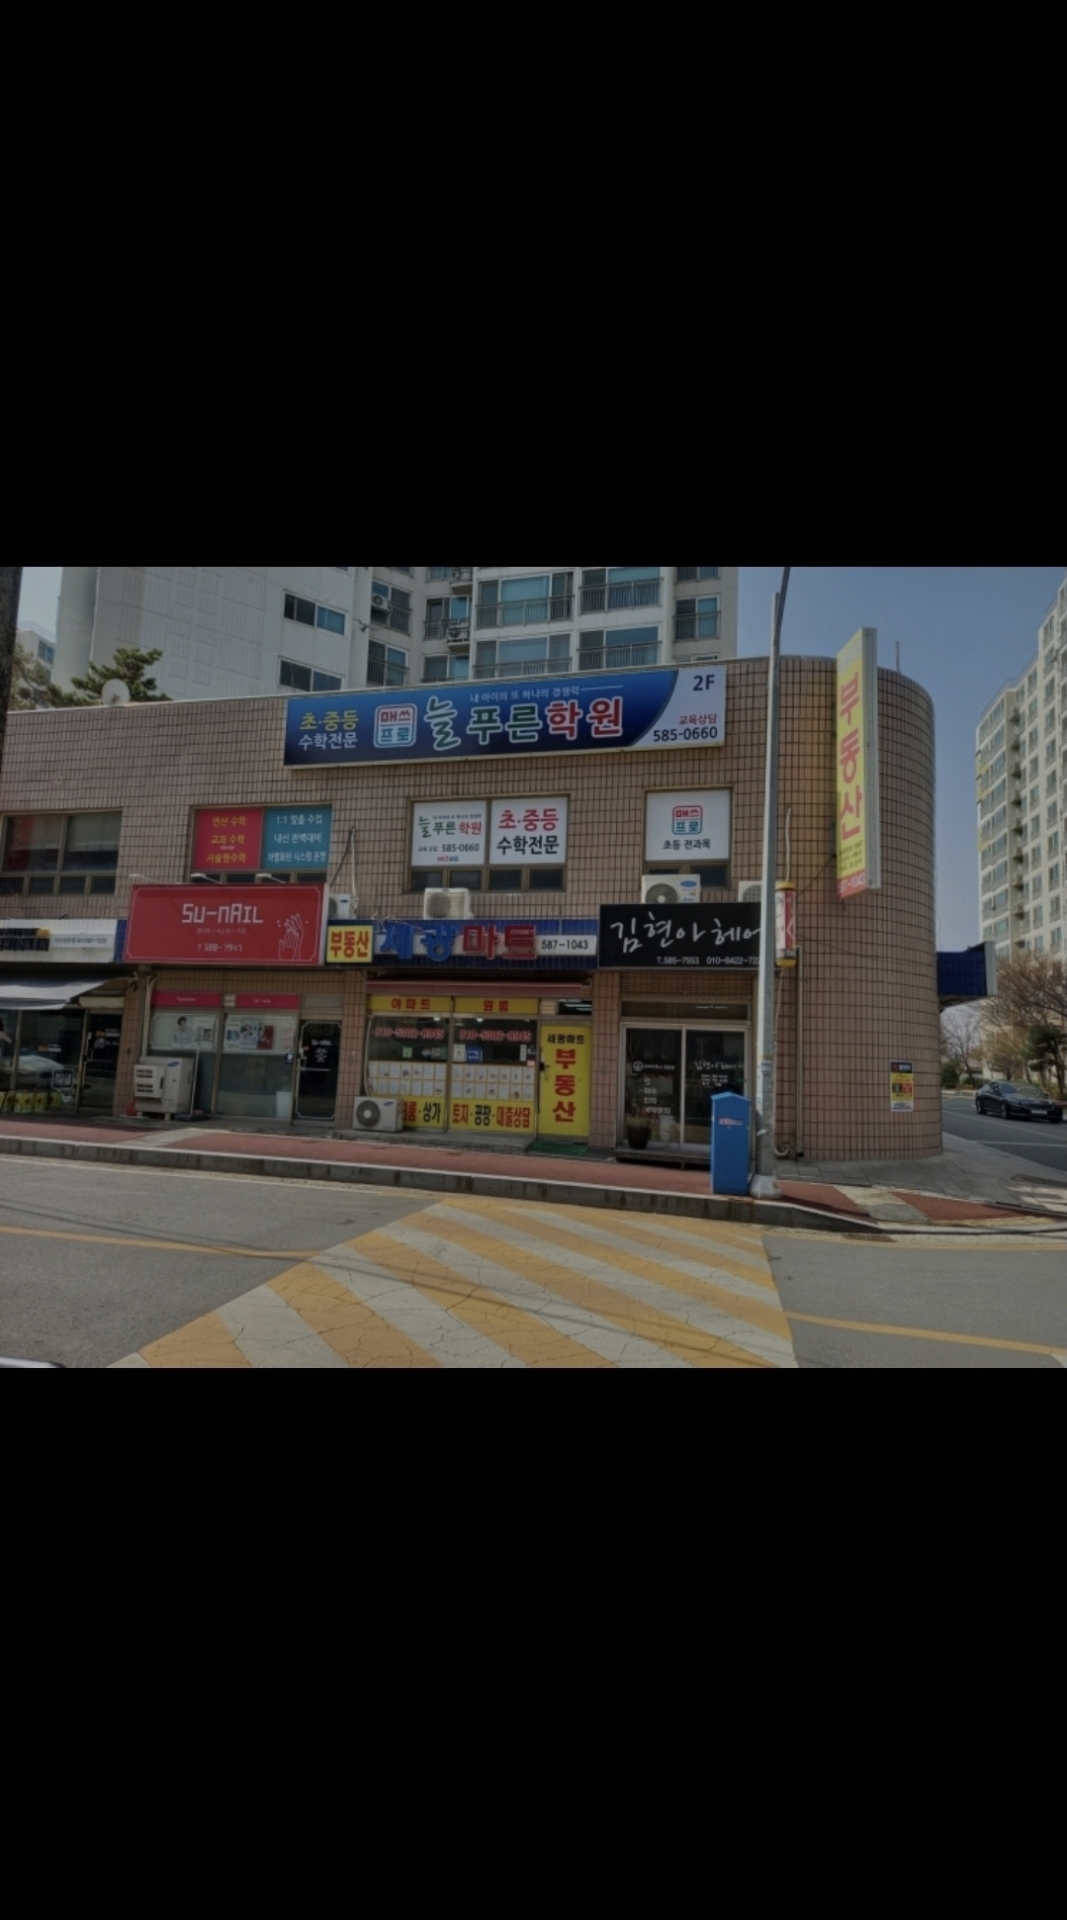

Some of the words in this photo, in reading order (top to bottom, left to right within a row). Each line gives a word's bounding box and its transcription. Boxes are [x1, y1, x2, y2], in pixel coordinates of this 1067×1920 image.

[692, 674, 715, 692] 2F
[470, 693, 479, 703] 내
[482, 691, 508, 702] 아이의
[522, 687, 549, 700] 하나의
[552, 685, 580, 698] 경쟁력
[678, 712, 717, 726] 교육상담
[298, 732, 358, 750] 수학전문
[379, 725, 411, 742] 프로
[653, 726, 718, 742] 585-0660
[839, 671, 863, 840] 부동산
[230, 815, 247, 826] 수학
[229, 834, 245, 845] 수학
[442, 842, 480, 852] 585-0660
[496, 835, 560, 856] 수학전문
[662, 839, 681, 850] 초등
[683, 838, 712, 850] 전과목
[330, 930, 369, 958] 부동산
[380, 922, 537, 962] 세광마트
[541, 939, 589, 950] 587-1043
[391, 998, 431, 1010] 아파트
[482, 999, 510, 1012] 원룸
[547, 1033, 585, 1045] 세광마트
[552, 1048, 577, 1123] 부동산
